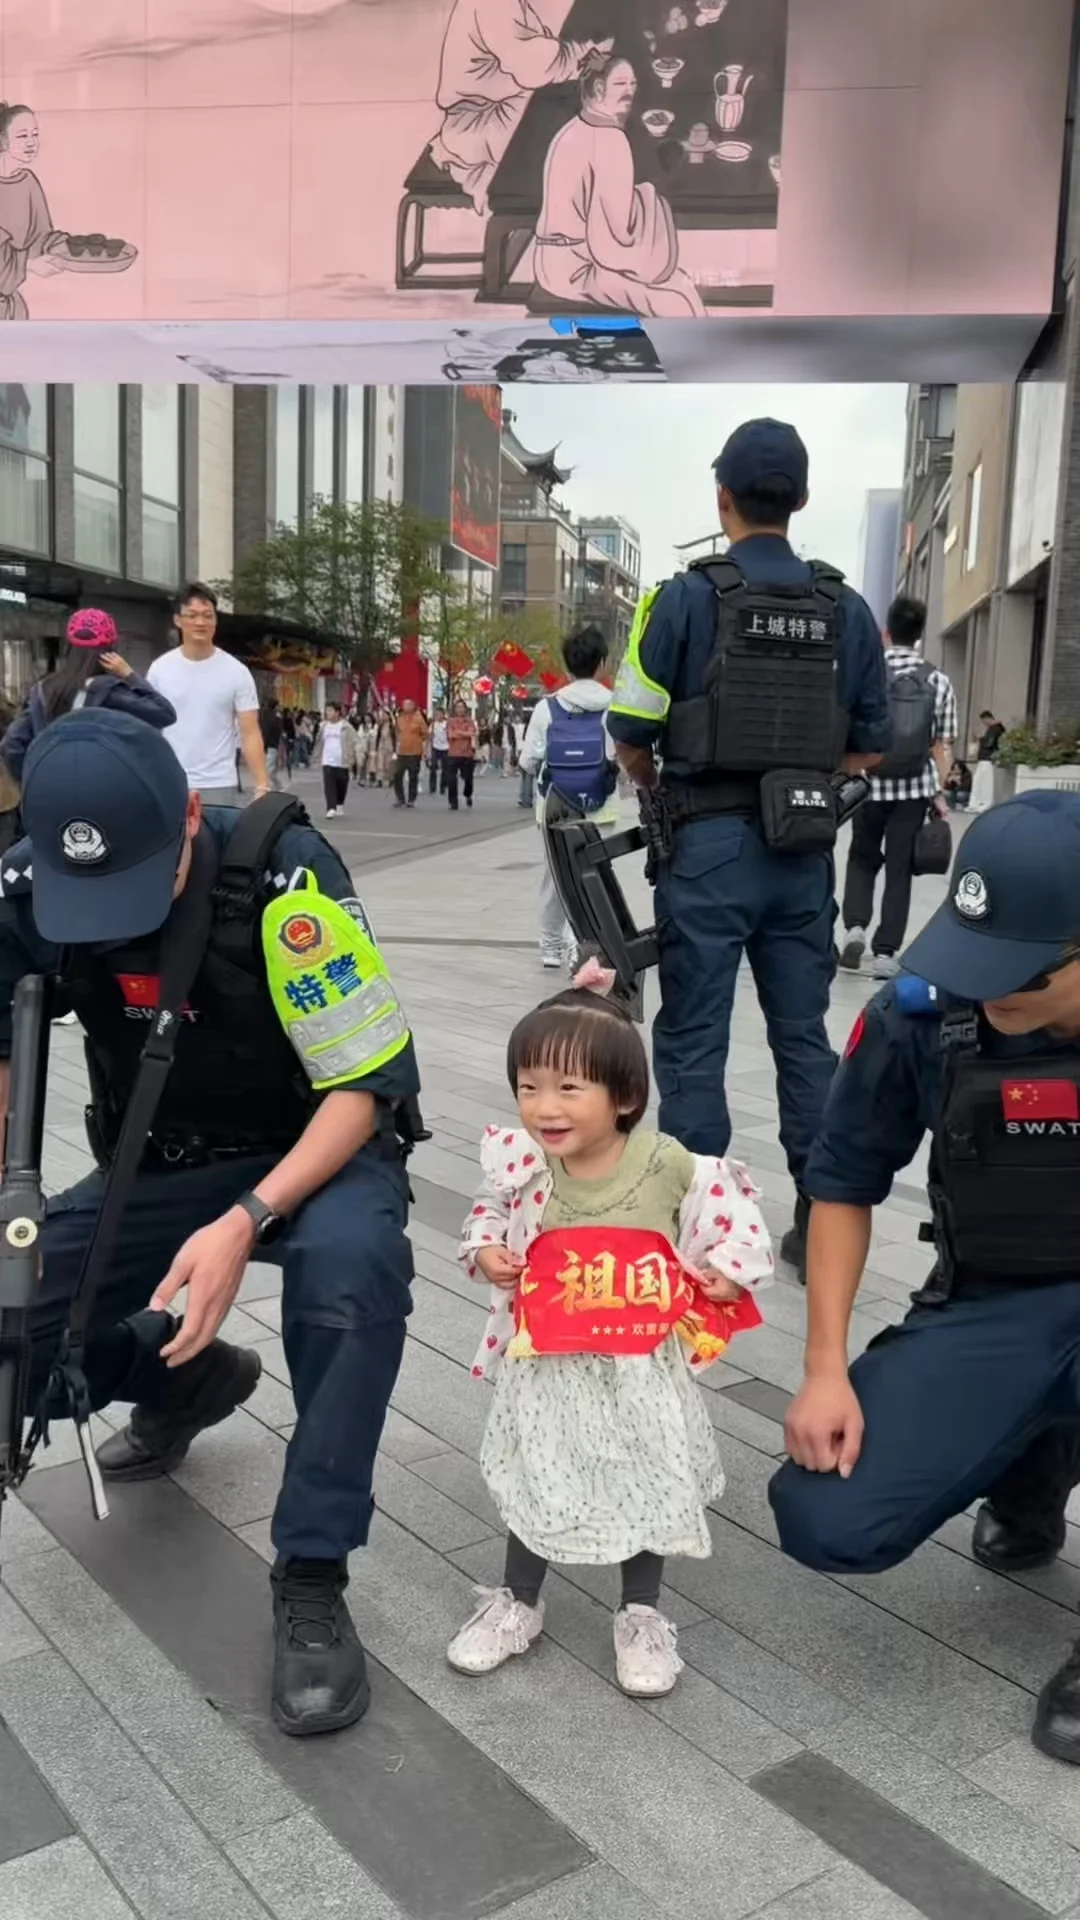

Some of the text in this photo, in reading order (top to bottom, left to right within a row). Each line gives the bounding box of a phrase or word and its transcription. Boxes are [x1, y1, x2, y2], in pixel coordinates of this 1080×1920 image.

[745, 613, 827, 641] 上城特警
[284, 952, 363, 1014] 特警
[123, 1006, 200, 1023] SWT
[1006, 1121, 1080, 1135] SWAT
